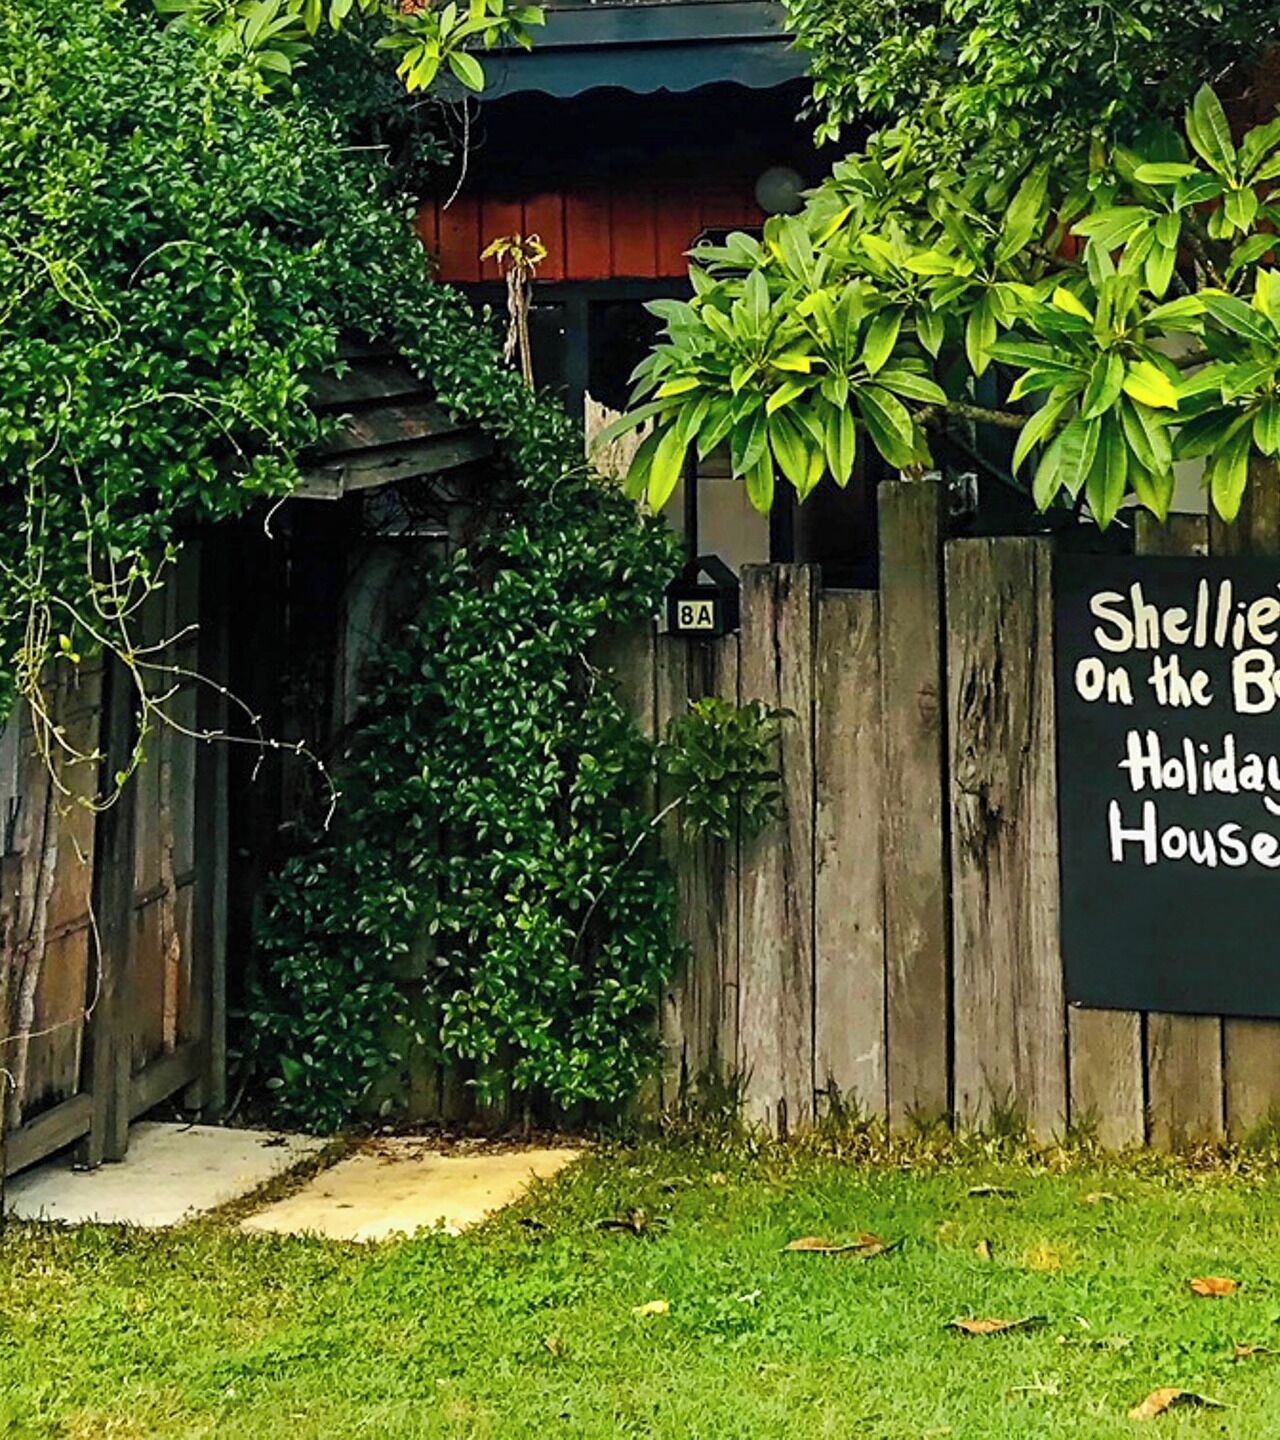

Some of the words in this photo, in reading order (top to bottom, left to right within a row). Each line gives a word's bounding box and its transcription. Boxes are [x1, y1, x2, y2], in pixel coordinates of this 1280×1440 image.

[681, 605, 711, 626] 8A
[1074, 656, 1134, 705] On
[1148, 653, 1214, 708] the
